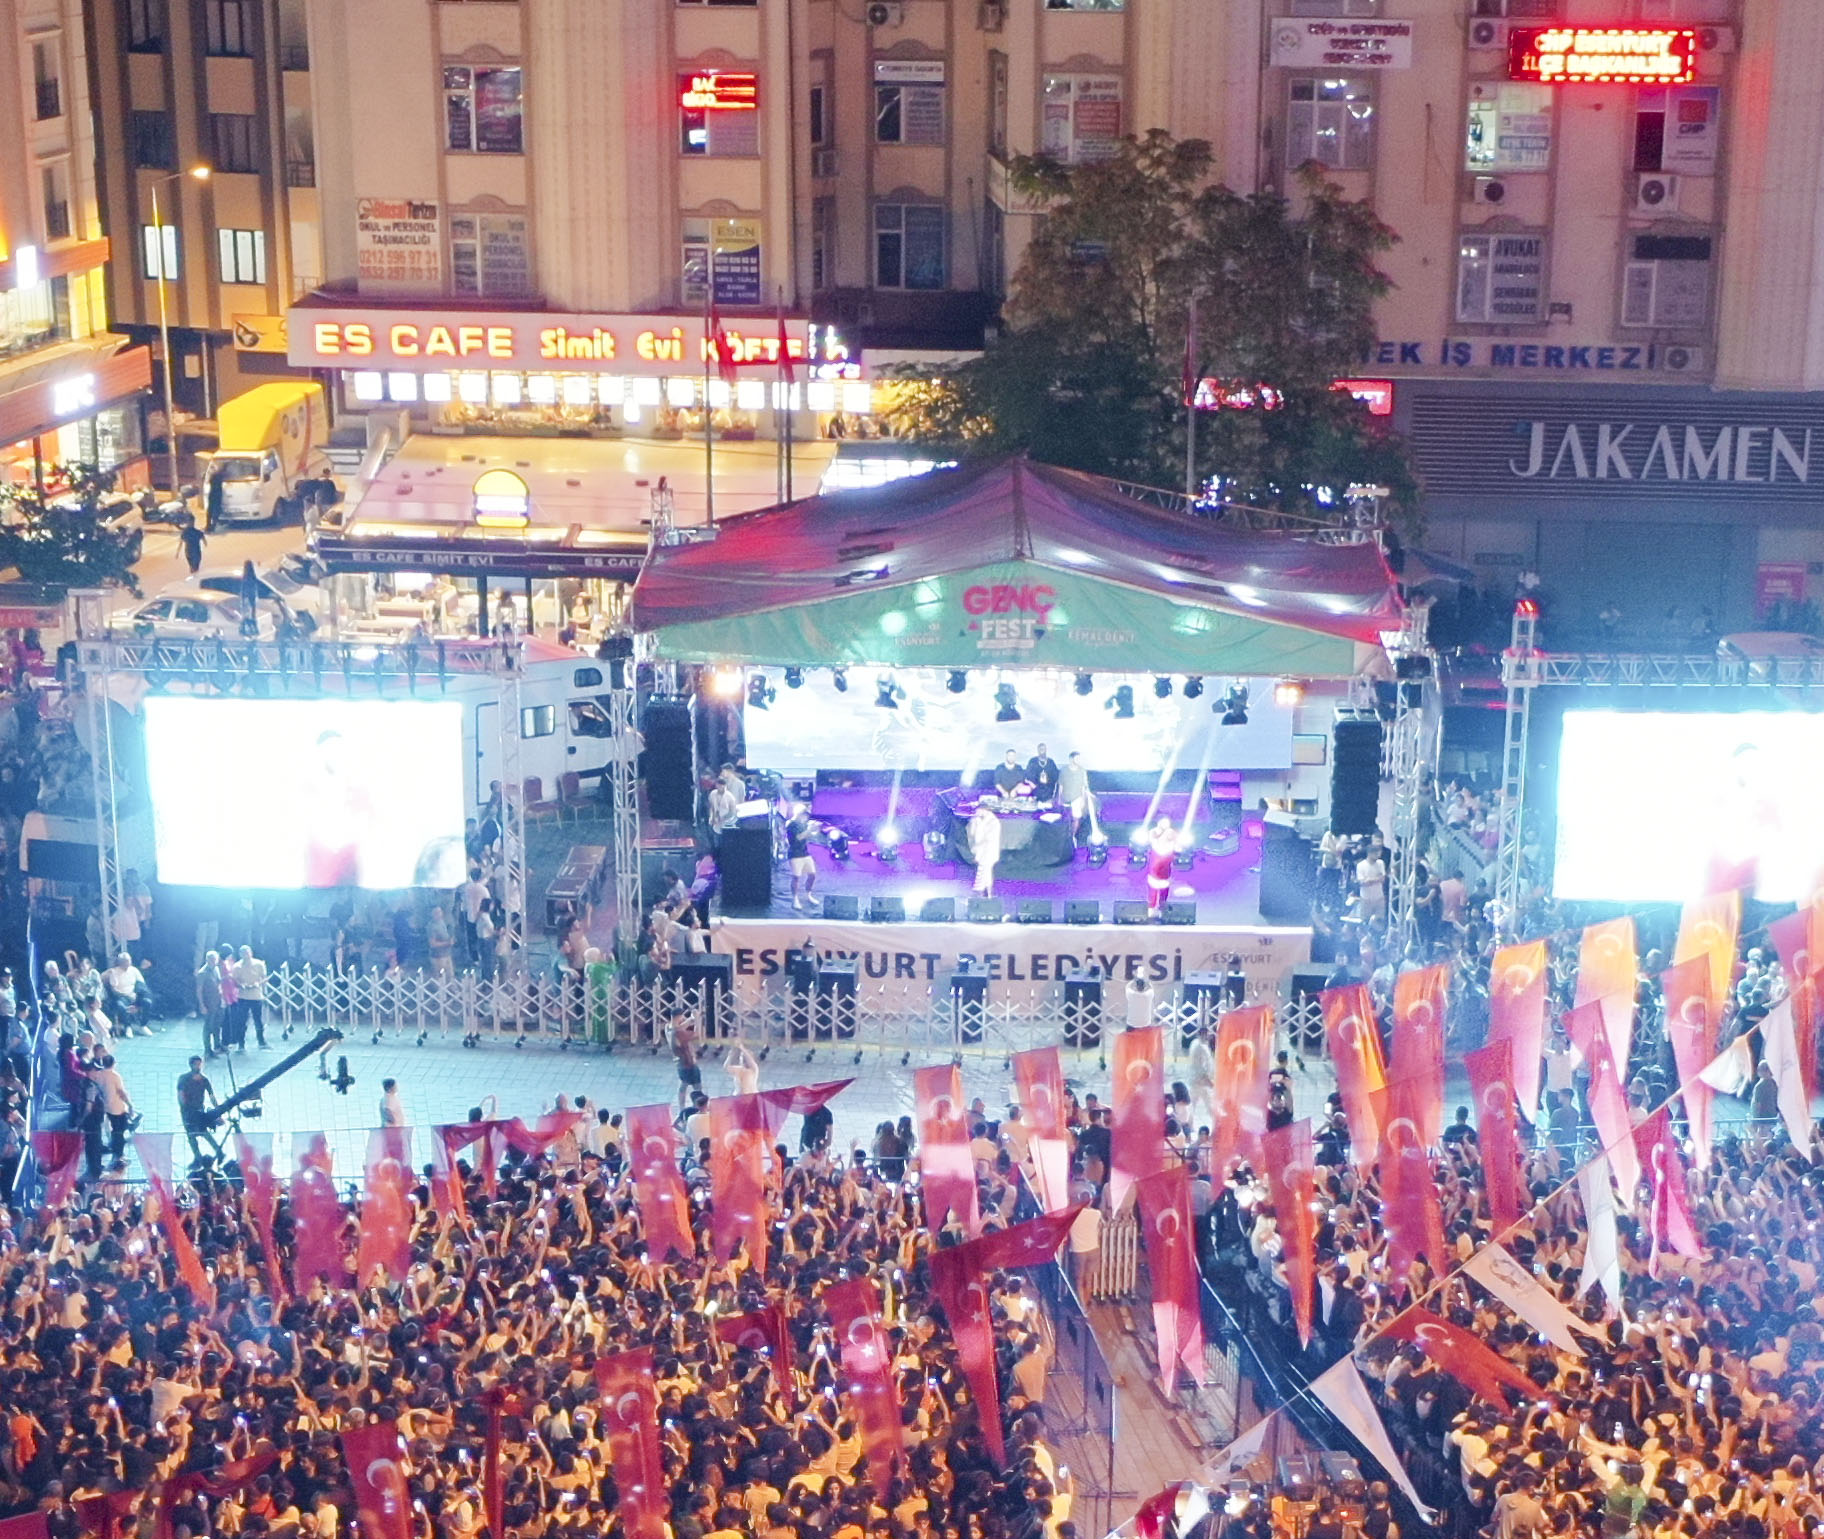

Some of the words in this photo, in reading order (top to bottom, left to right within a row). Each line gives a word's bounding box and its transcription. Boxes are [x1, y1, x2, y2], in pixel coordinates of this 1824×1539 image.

[1679, 123, 1706, 134] CHP
[359, 222, 381, 233] OKUL
[392, 222, 437, 233] PERSONEL
[372, 234, 431, 246] TAŞIMACILIĞI
[1494, 239, 1540, 257] AVUKAT
[359, 250, 384, 265] 0212
[408, 250, 422, 265] 97
[359, 266, 385, 280] 0532
[314, 322, 372, 356] ES
[390, 324, 514, 358] CAFE
[540, 327, 616, 360] Simit
[636, 327, 684, 361] Evi
[1441, 339, 1472, 367] İŞ
[1509, 422, 1811, 482] JAKAMEN
[352, 553, 371, 562] ES
[375, 553, 415, 563] CAFE
[423, 552, 464, 565] SİMİT
[467, 554, 494, 566] EVİ
[584, 557, 604, 568] ES
[962, 584, 1056, 624] GENÇ
[981, 619, 1038, 638] FEST
